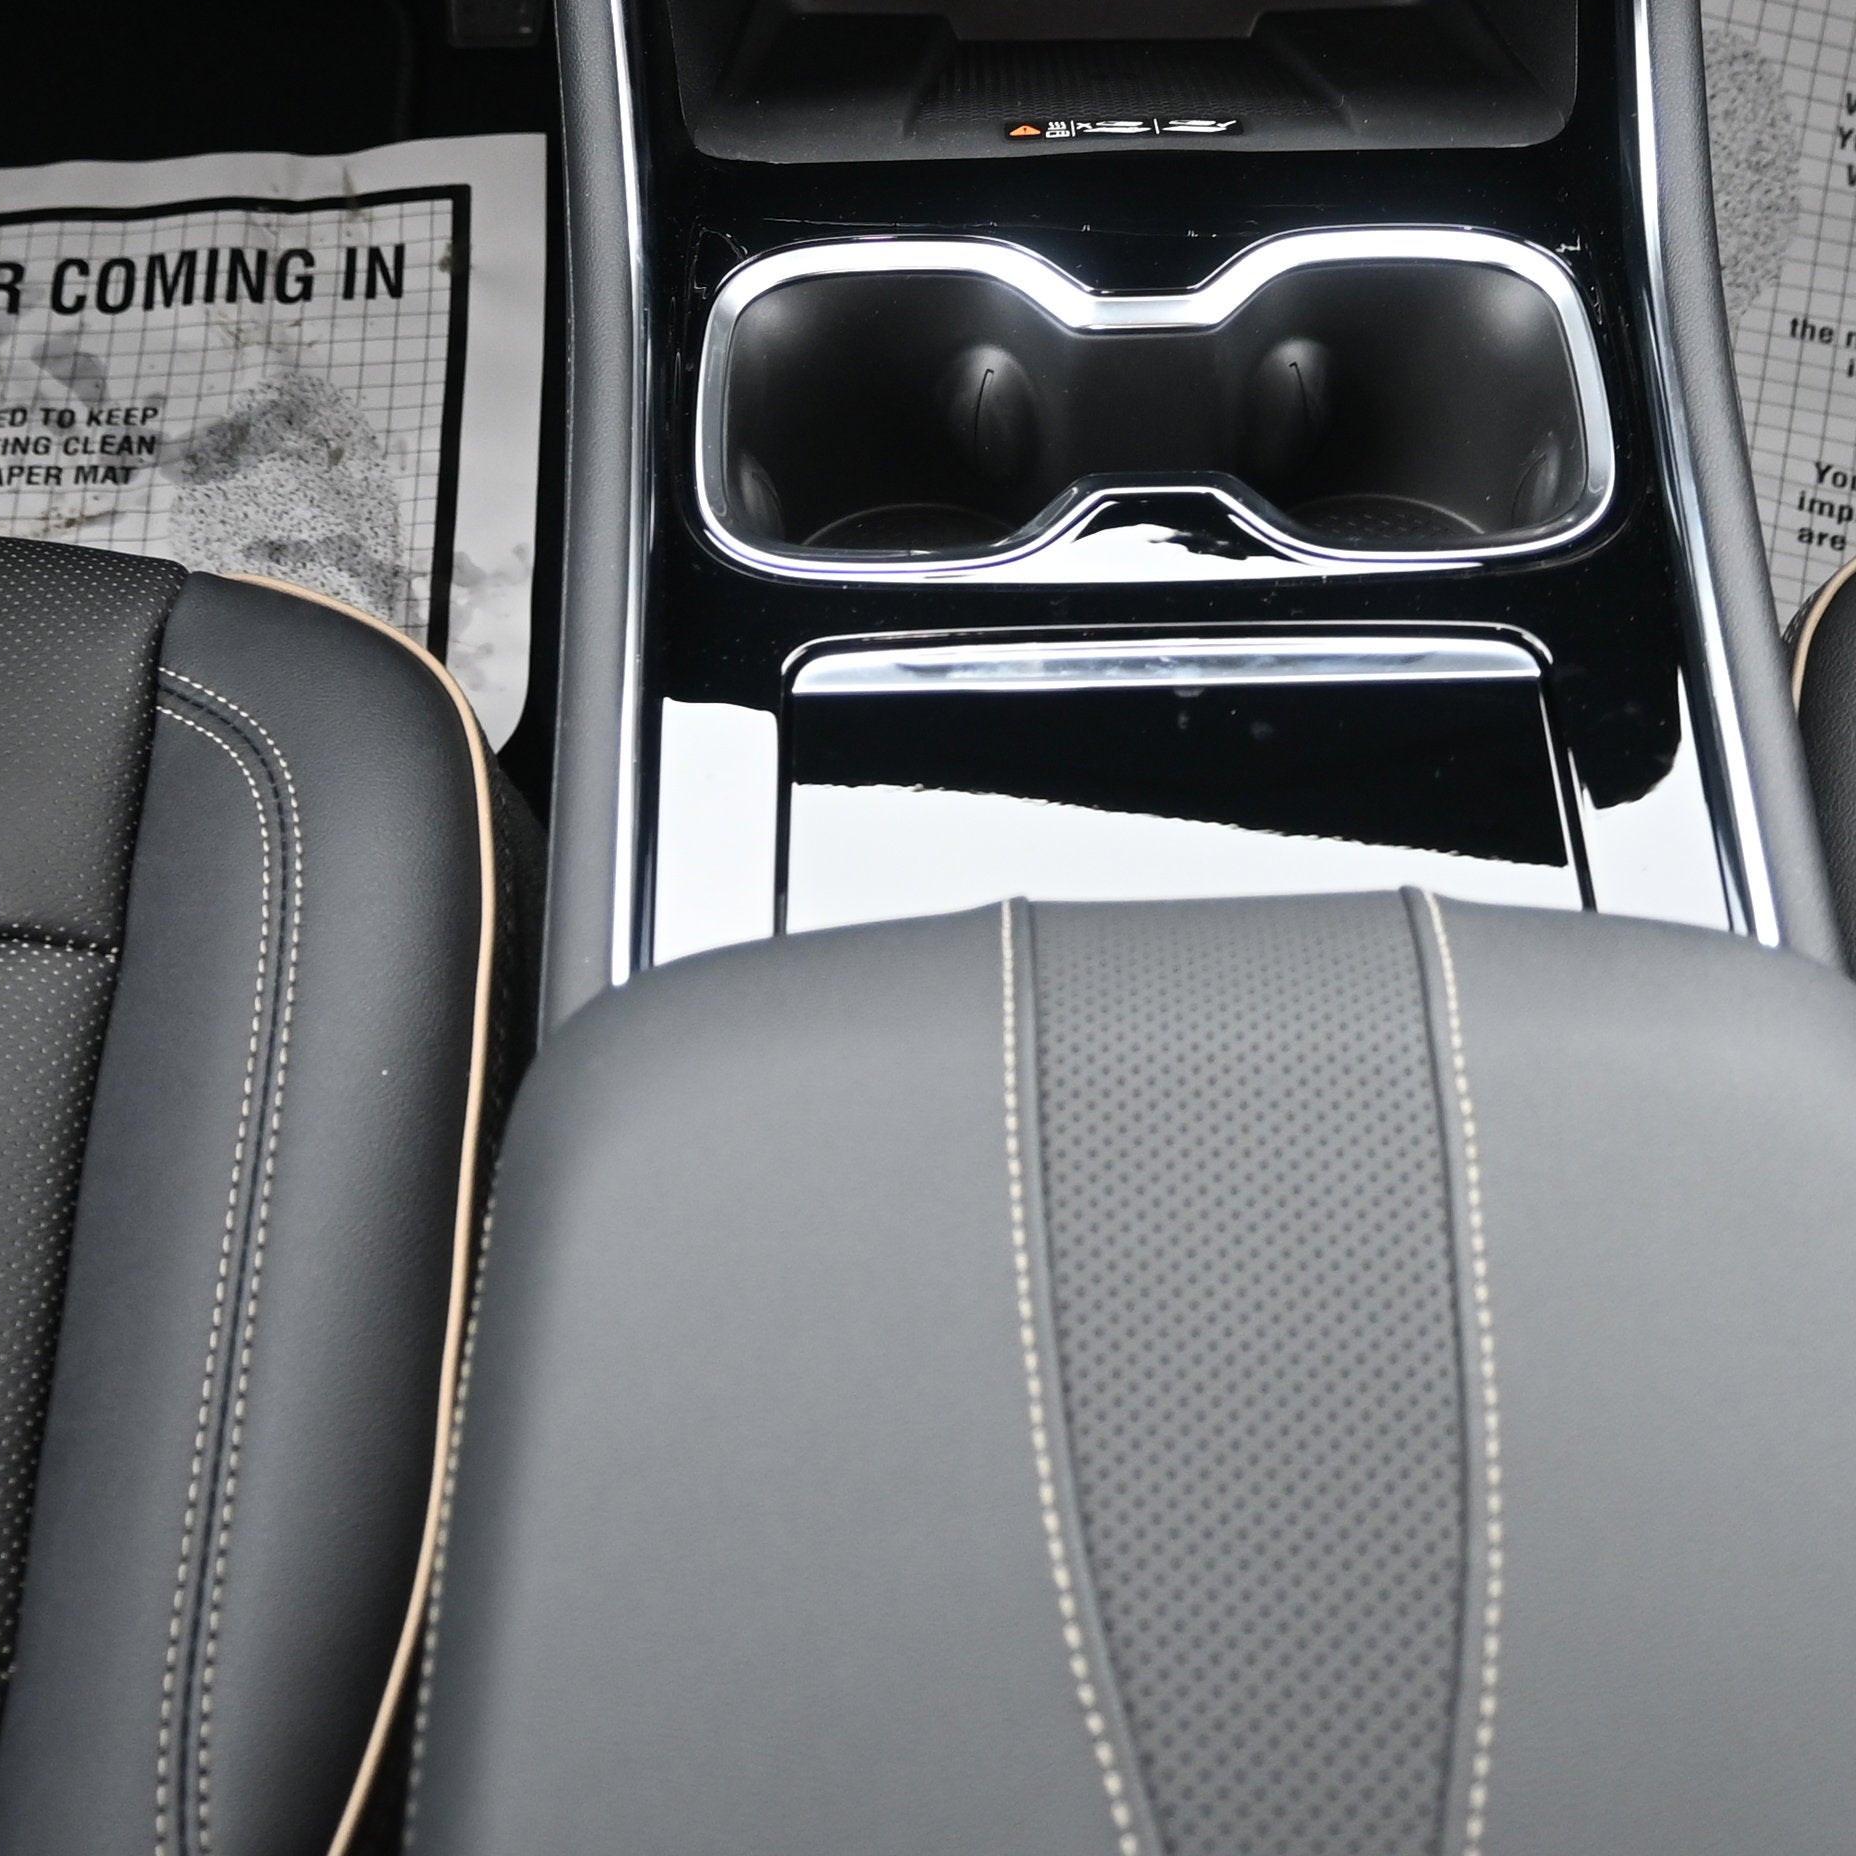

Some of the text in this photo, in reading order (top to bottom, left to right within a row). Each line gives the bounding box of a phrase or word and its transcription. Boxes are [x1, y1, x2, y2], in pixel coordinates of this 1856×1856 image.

[50, 247, 316, 316] COMING
[343, 244, 405, 300] IN
[1789, 317, 1834, 344] the
[40, 408, 76, 428] TO
[86, 407, 158, 427] KEEP
[62, 435, 157, 456] CLEAN
[74, 465, 137, 485] MAT
[1797, 527, 1846, 552] are
